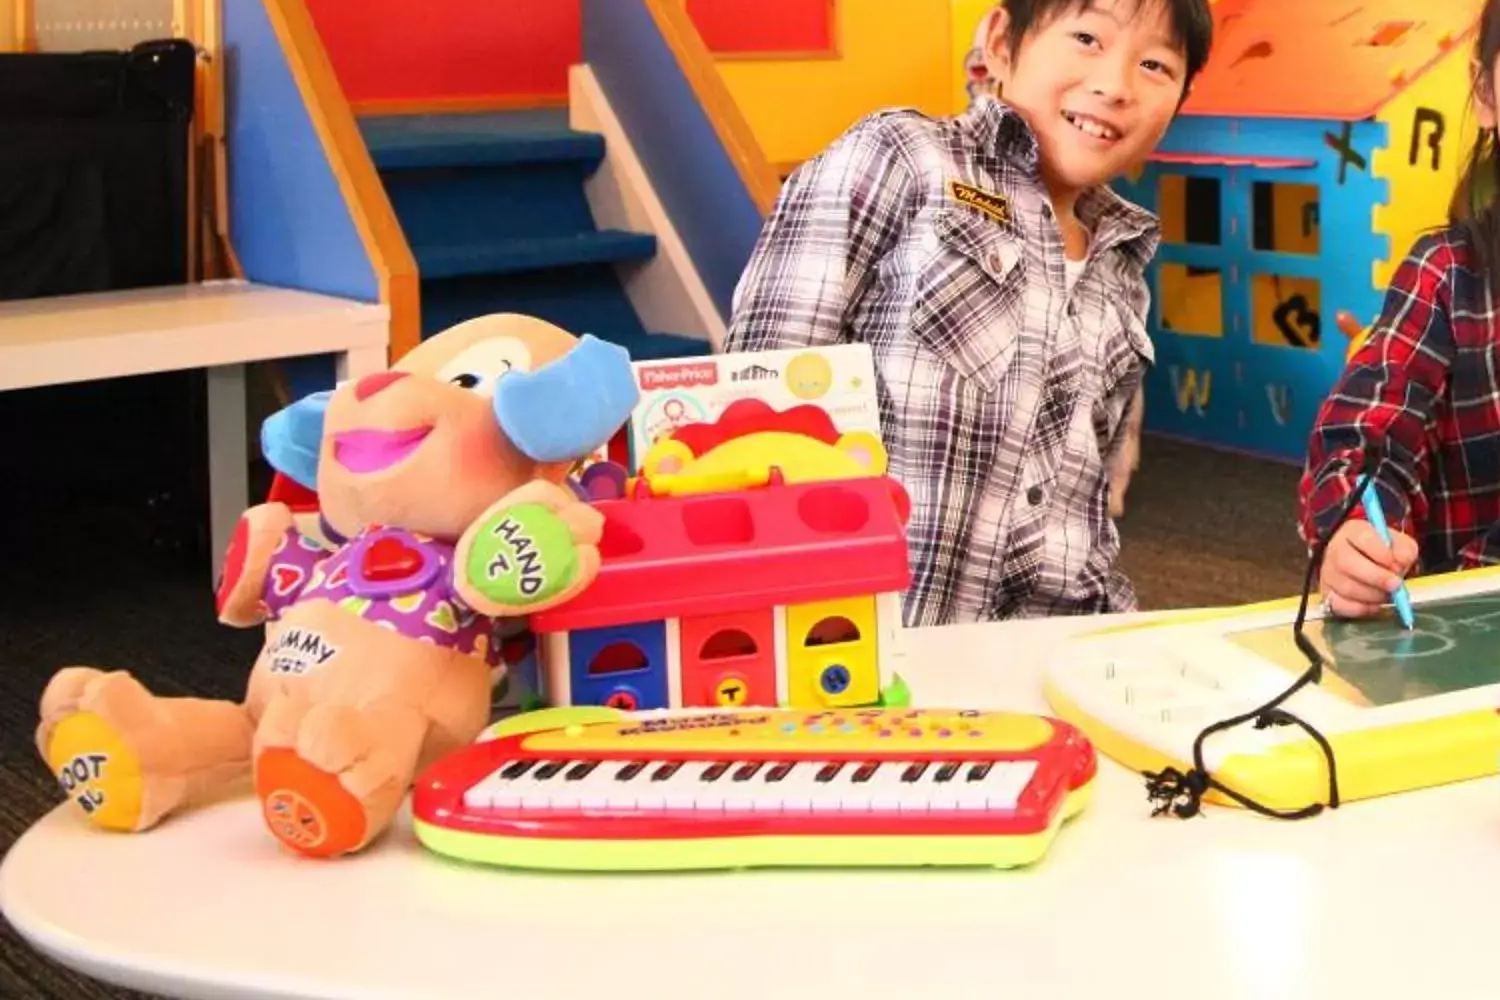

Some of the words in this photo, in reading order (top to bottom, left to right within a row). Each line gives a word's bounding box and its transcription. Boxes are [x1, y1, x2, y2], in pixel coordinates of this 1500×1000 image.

[1324, 120, 1367, 186] X
[1408, 106, 1445, 172] R
[493, 518, 543, 595] HAND
[60, 755, 107, 791] OOT
